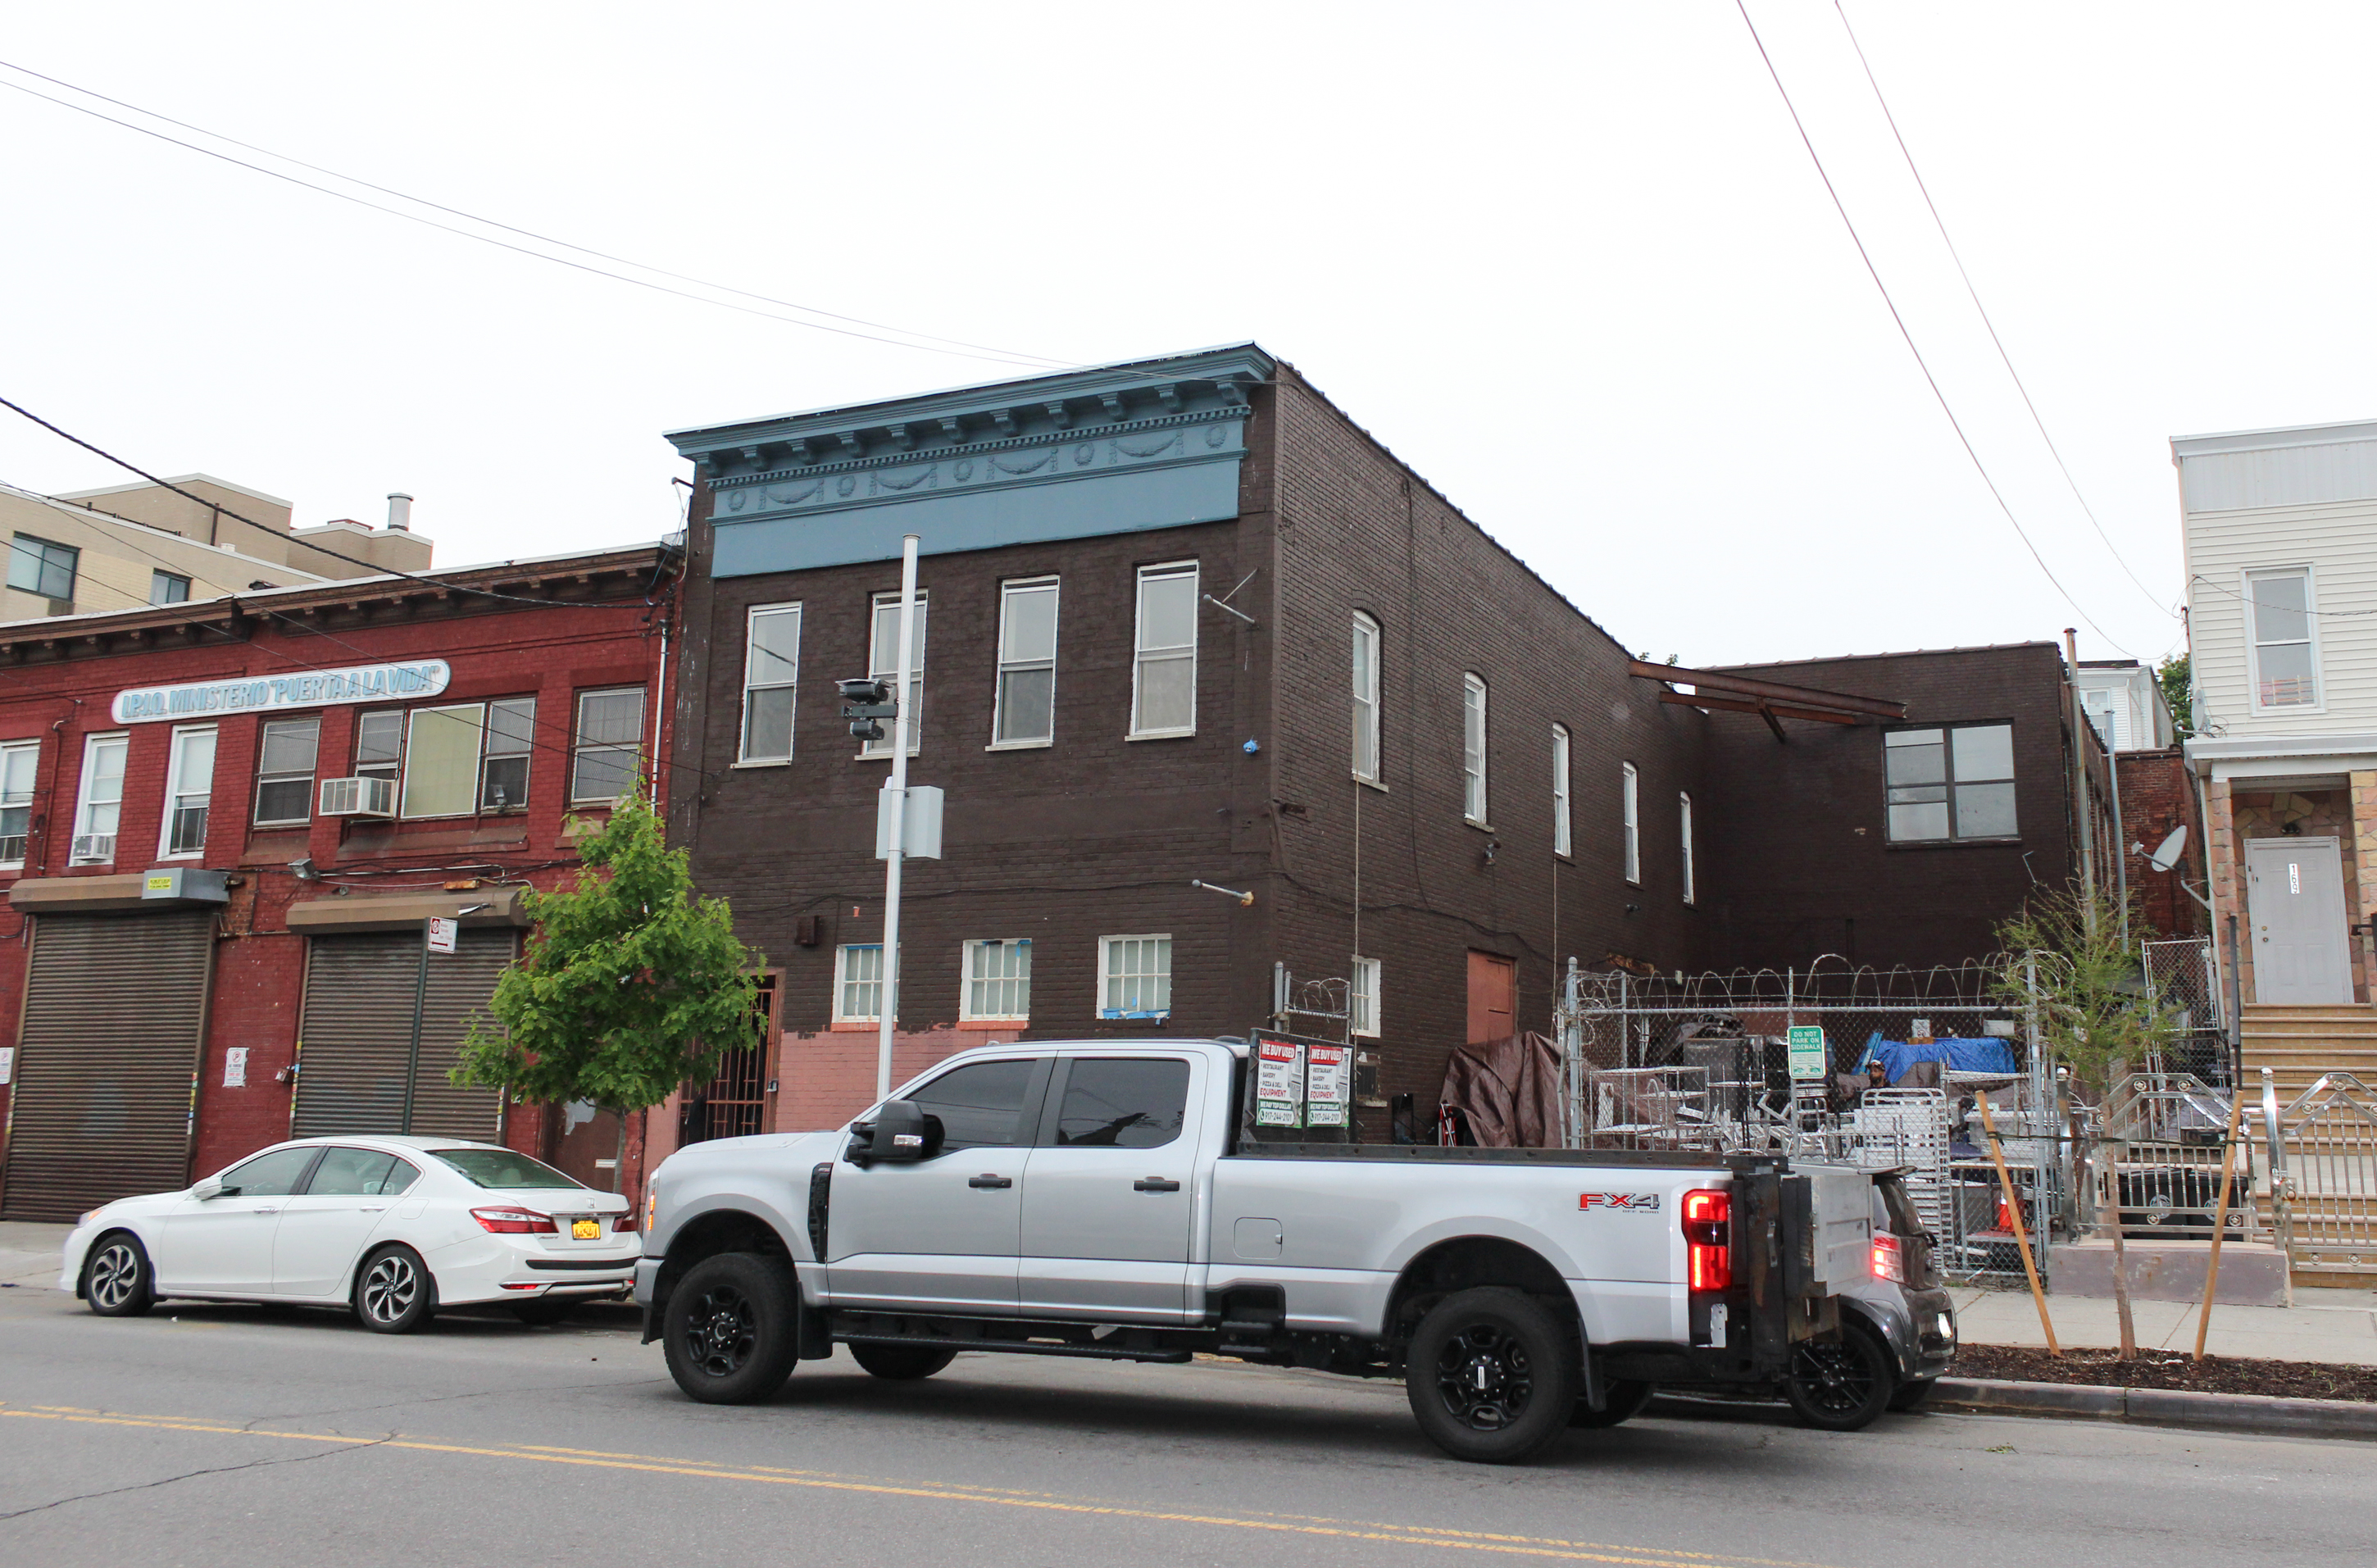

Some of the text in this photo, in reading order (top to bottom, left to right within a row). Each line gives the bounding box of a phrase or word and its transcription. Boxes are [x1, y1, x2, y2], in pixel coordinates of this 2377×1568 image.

[169, 681, 269, 713] MINISTERIO
[269, 675, 346, 702] "PUERTA
[346, 672, 361, 697] A
[362, 670, 387, 696] LA
[388, 665, 440, 693] VIDA"
[1262, 1043, 1294, 1058] WE BUY USED
[1311, 1048, 1342, 1061] WE BUY USED
[1260, 1088, 1287, 1098] EQUIPMENT
[1310, 1091, 1334, 1100] EQUIPMENT
[1578, 1192, 1660, 1211] FX4
